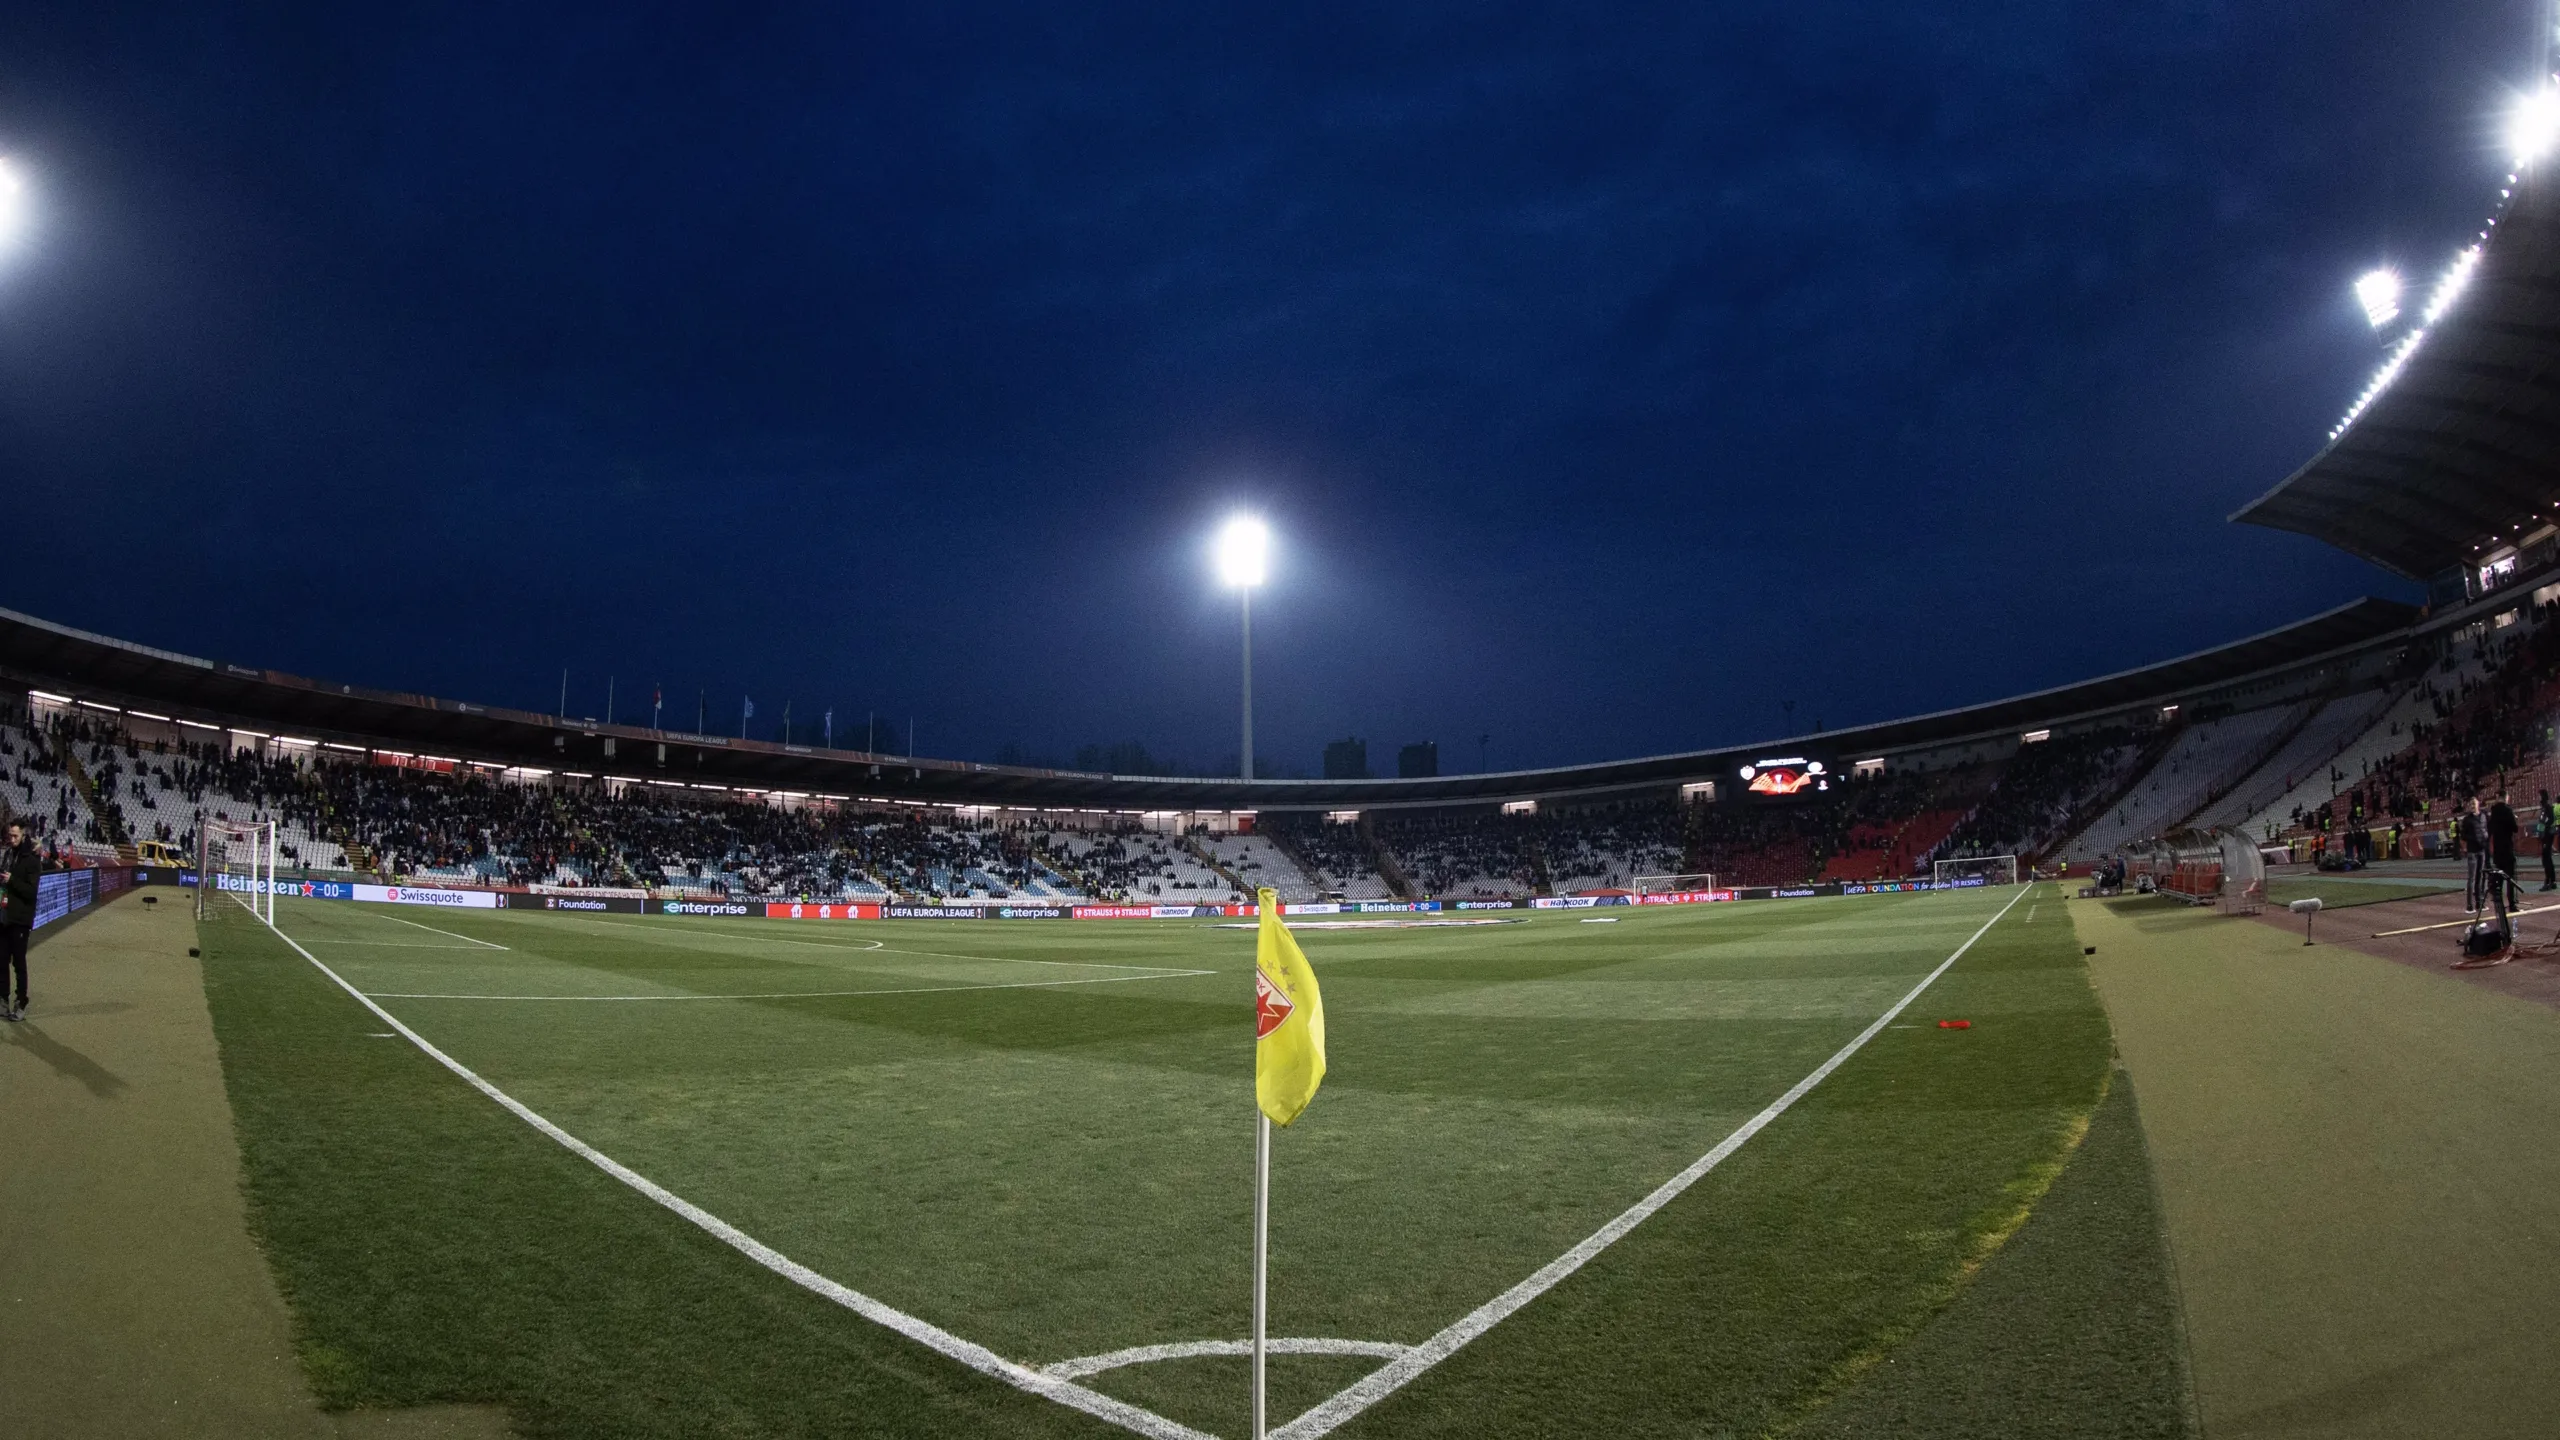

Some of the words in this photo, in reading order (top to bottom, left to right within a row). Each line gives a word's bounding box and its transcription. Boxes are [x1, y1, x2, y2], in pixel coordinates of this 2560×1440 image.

[1779, 889, 1815, 897] Foundation
[1847, 887, 1866, 895] UEFA
[1867, 882, 1920, 894] FOUNDATION
[400, 888, 464, 905] Swissquote
[558, 899, 607, 910] Foundation
[664, 901, 747, 916] enterprise
[1360, 903, 1408, 912] Heineken
[1457, 901, 1513, 910] enterprise
[891, 908, 912, 917] UEFA
[914, 908, 943, 918] EUROPA
[945, 908, 975, 918] LEAGUE
[1000, 908, 1060, 919] enterprise
[1083, 908, 1114, 917] STRAUSS
[1121, 908, 1150, 917] STRAUSS
